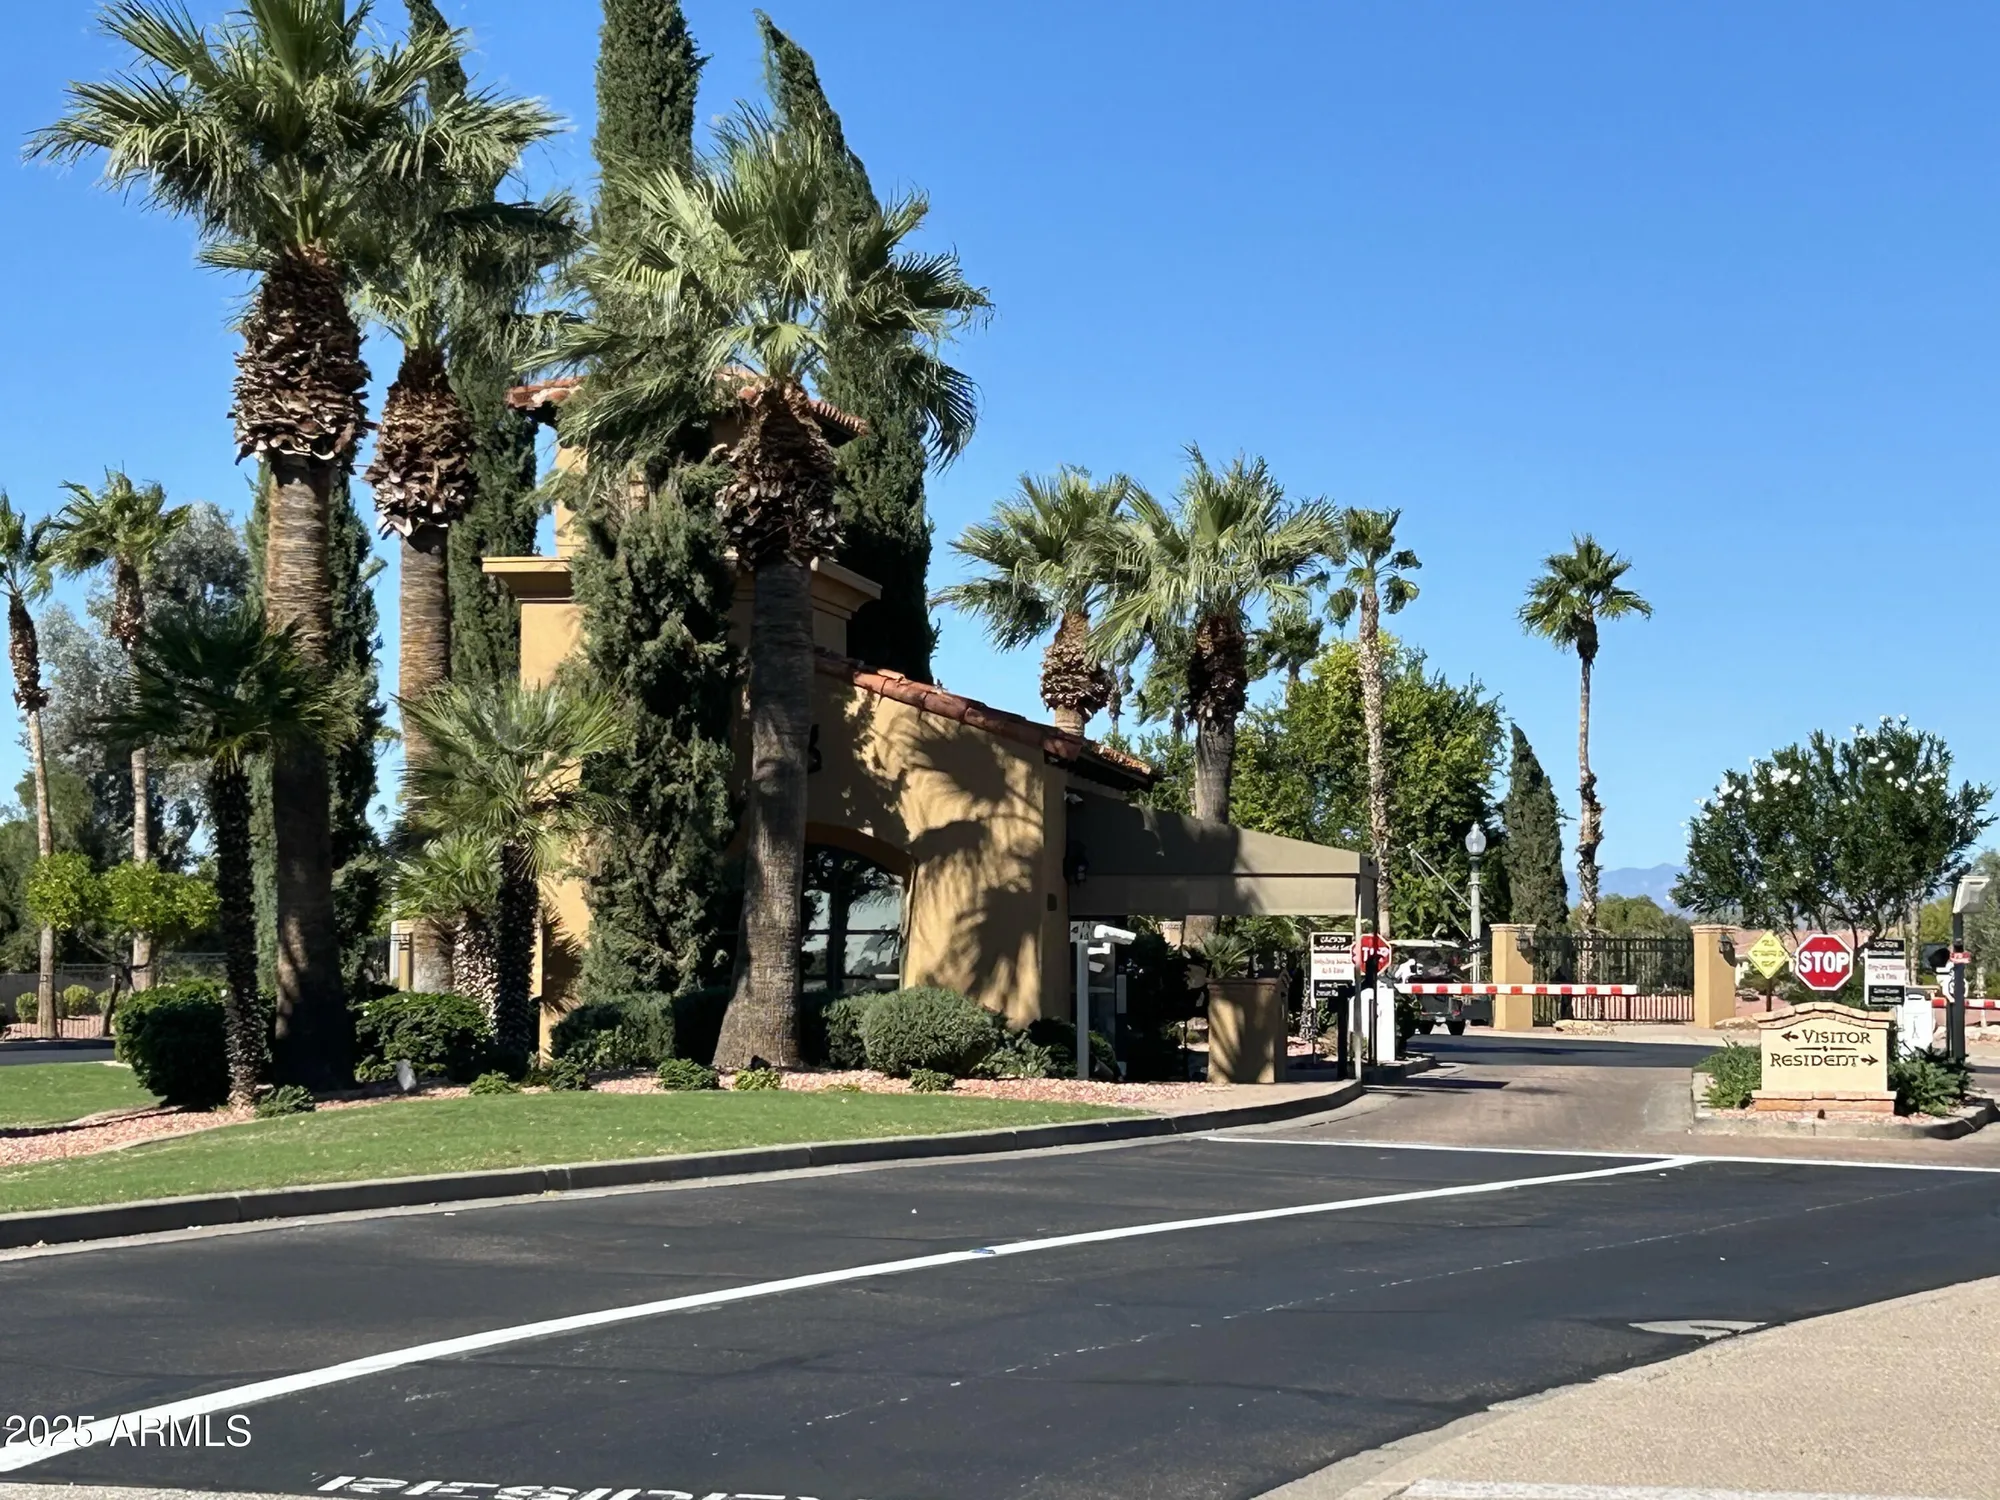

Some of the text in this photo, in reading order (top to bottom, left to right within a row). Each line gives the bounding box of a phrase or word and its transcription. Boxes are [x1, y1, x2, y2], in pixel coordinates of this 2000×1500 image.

[1799, 951, 1850, 973] STOP
[1802, 1029, 1872, 1044] VISITOR
[1770, 1052, 1859, 1068] RESIDENT
